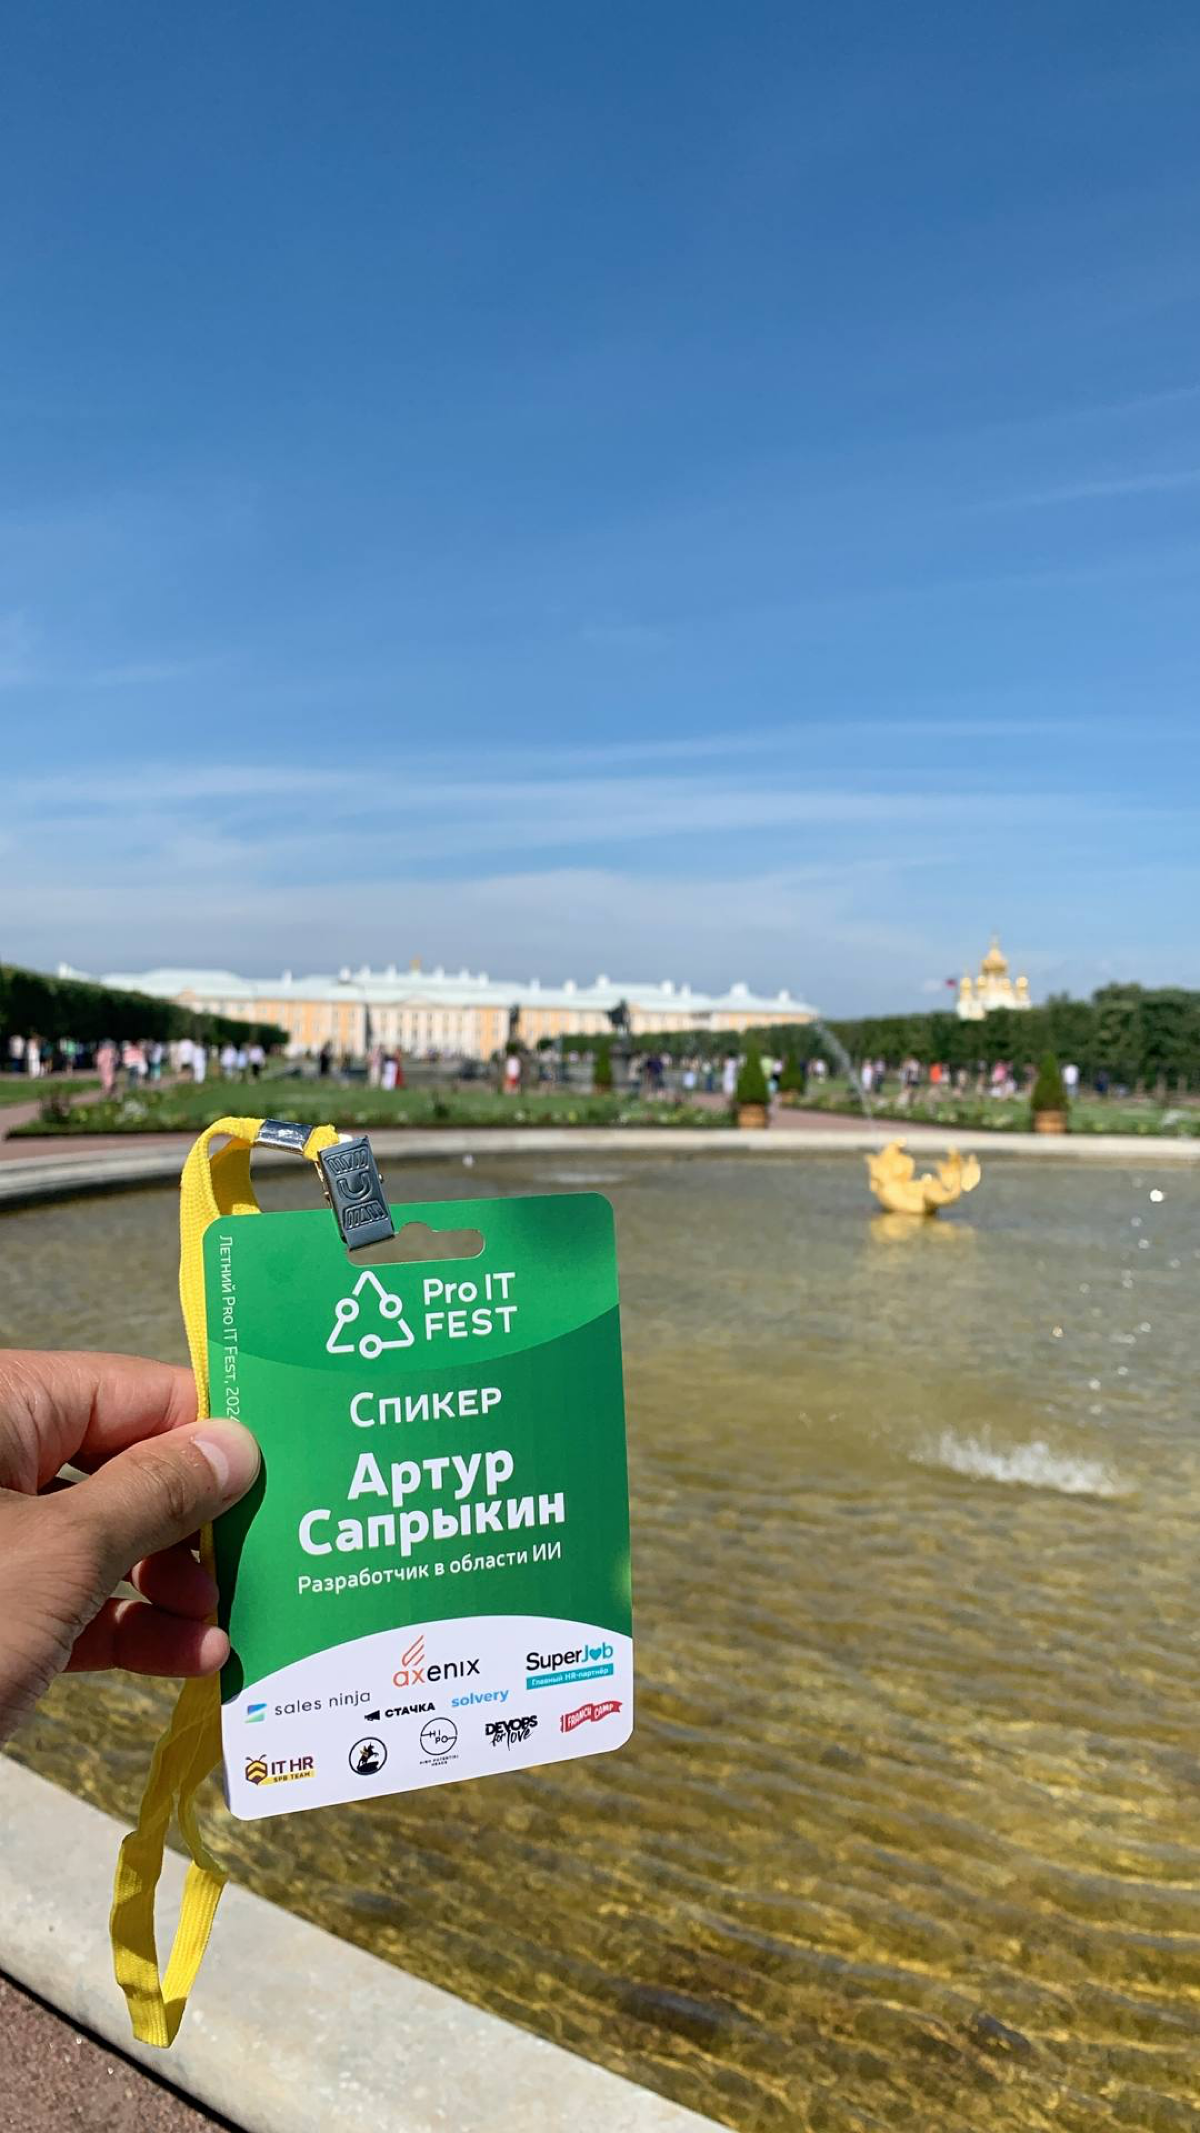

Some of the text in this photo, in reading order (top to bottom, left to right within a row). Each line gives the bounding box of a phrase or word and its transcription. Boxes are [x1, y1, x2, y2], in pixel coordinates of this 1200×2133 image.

[423, 1272, 516, 1305] Pro IT
[224, 1329, 238, 1341] IT
[424, 1305, 518, 1340] FEST
[347, 1449, 515, 1508] Артур
[298, 1492, 566, 1557] Сапрыкин
[298, 1541, 562, 1595] Разработчик в области ИИ
[393, 1659, 481, 1687] axenix
[275, 1691, 371, 1716] sales ninja
[385, 1702, 436, 1718] СТАЧКА
[451, 1690, 509, 1707] solvery
[485, 1715, 538, 1735] DEVOPS
[271, 1756, 314, 1775] IT HR
[291, 1771, 311, 1780] TEAM
